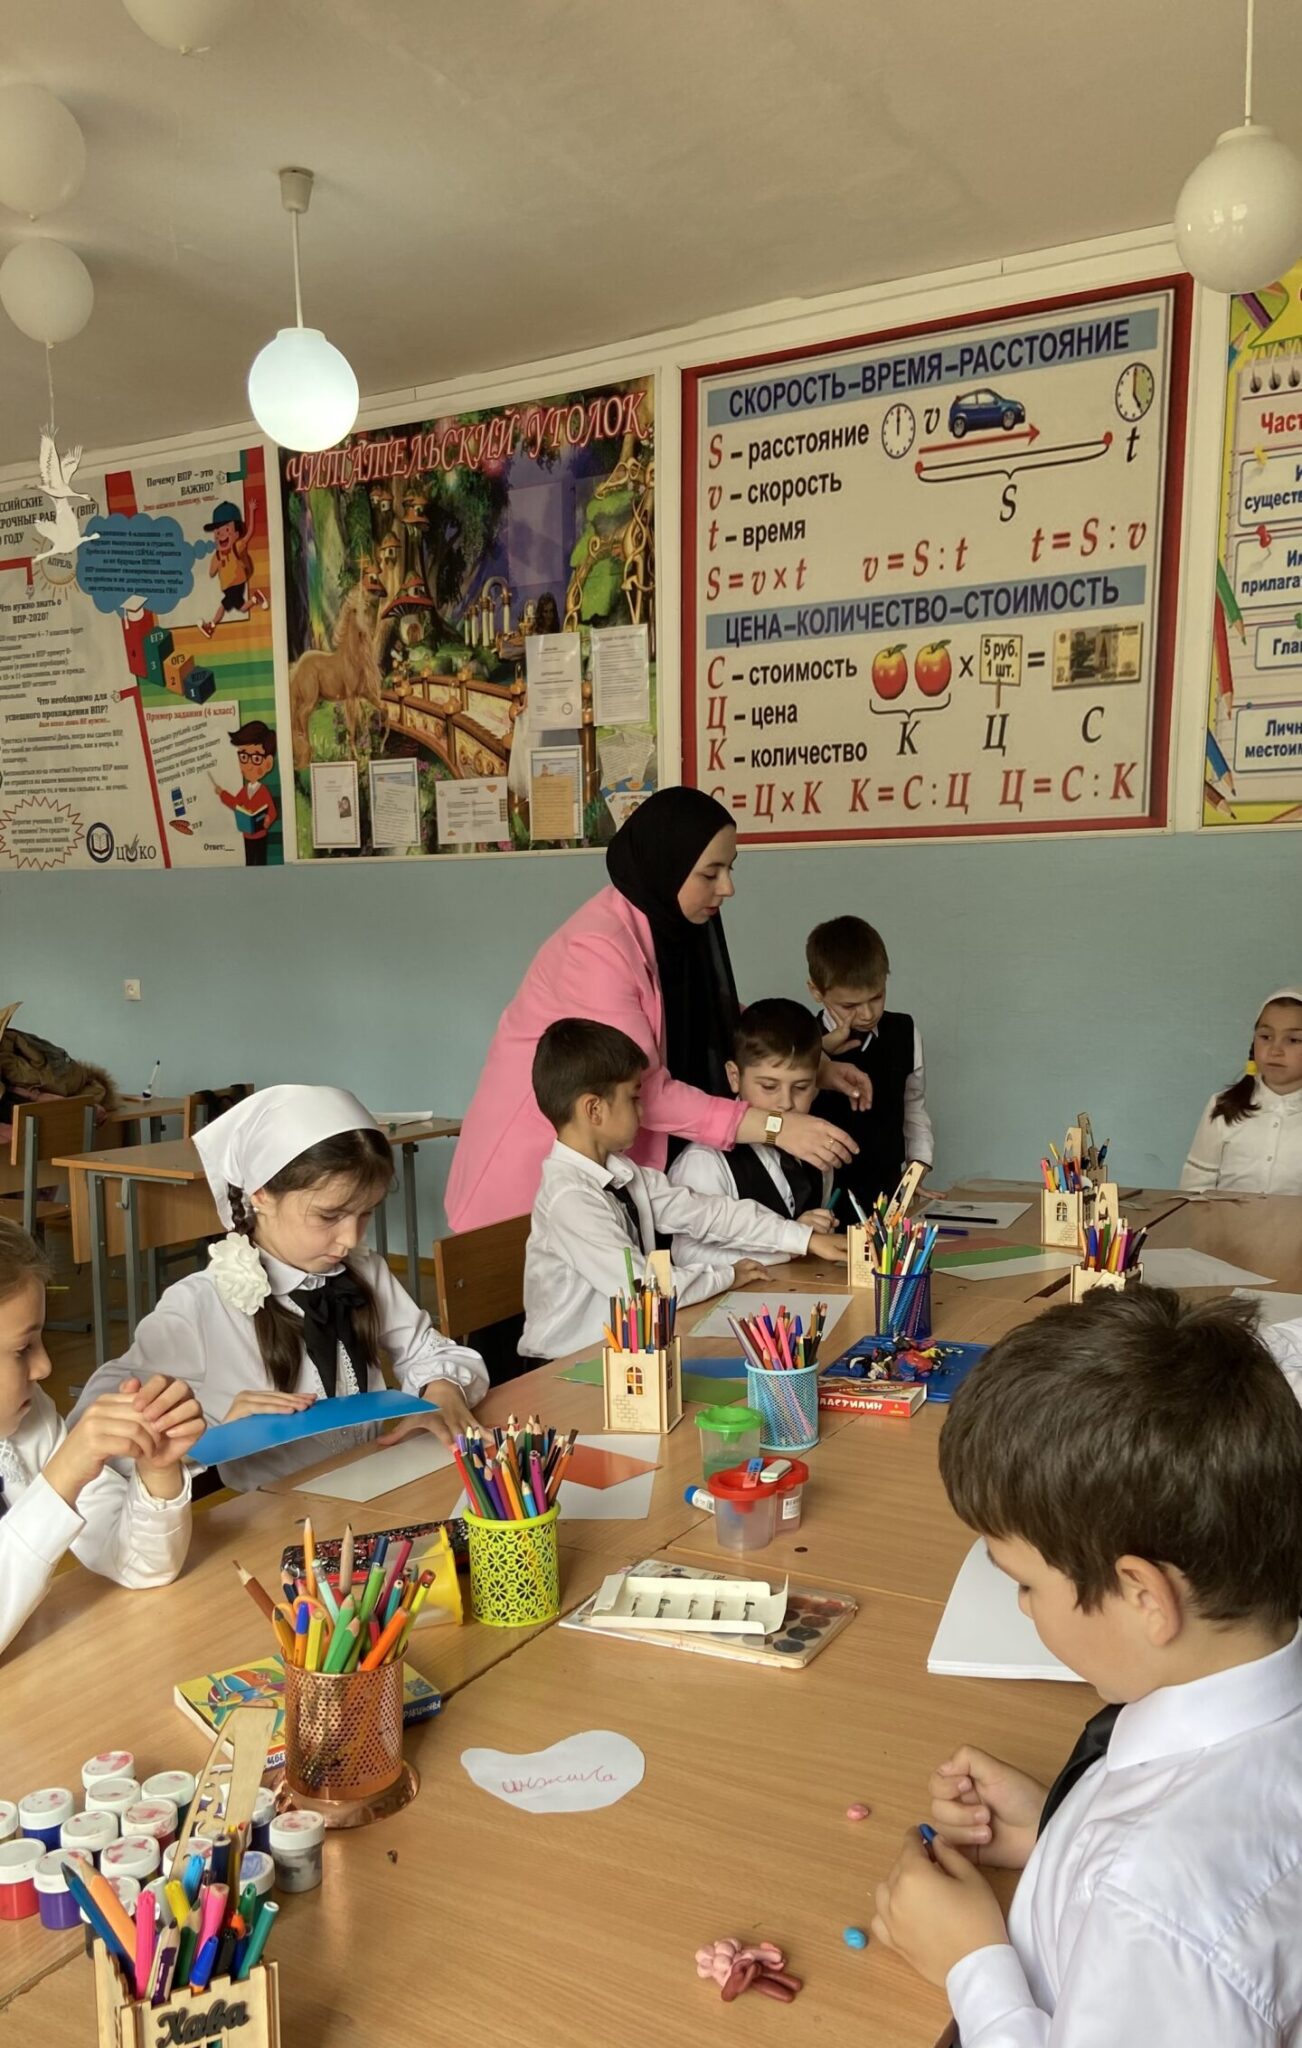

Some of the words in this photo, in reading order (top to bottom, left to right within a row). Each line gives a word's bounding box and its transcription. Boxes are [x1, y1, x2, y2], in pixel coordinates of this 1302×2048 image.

[923, 404, 941, 435] v
[285, 408, 520, 492] ЧИТАТЕЛЬСКИЙ
[526, 390, 648, 459] УГОЛОК
[708, 433, 723, 470] S
[749, 422, 869, 469] расстояние
[1125, 426, 1141, 464] t
[147, 474, 175, 488] Почему
[177, 470, 192, 482] ВПР
[200, 469, 213, 479] это
[180, 481, 214, 497] ВАЖНО?
[747, 472, 843, 506] скорость
[999, 484, 1018, 523] S
[4, 531, 25, 546] ГОДУ
[743, 518, 806, 552] время
[47, 557, 73, 570] АПРЕЛЬ
[1241, 575, 1302, 597] прилага
[984, 638, 991, 656] 5
[993, 639, 1018, 661] руб.
[1273, 638, 1302, 656] Гла
[150, 661, 157, 671] 3
[171, 653, 186, 665] ОГЭ
[986, 659, 992, 677] 1
[995, 664, 1015, 678] шт.
[171, 676, 176, 686] 2
[749, 657, 858, 686] стоимость
[37, 696, 49, 706] Что
[51, 694, 93, 705] необходимо
[94, 692, 107, 702] для
[190, 688, 196, 698] 1
[5, 711, 41, 723] успешного
[42, 707, 89, 719] прохождения
[90, 705, 108, 715] ВПР?
[146, 711, 172, 722] Пример
[174, 709, 203, 720] задания
[706, 695, 728, 737] Ц
[752, 703, 798, 730] цена
[1081, 705, 1105, 743] С
[896, 719, 921, 756] К
[982, 712, 1010, 756] Ц
[706, 738, 727, 772] К
[751, 741, 868, 768] количество
[820, 1397, 883, 1411] ЛАСТИЛИН
[155, 1998, 251, 2047] Хава
